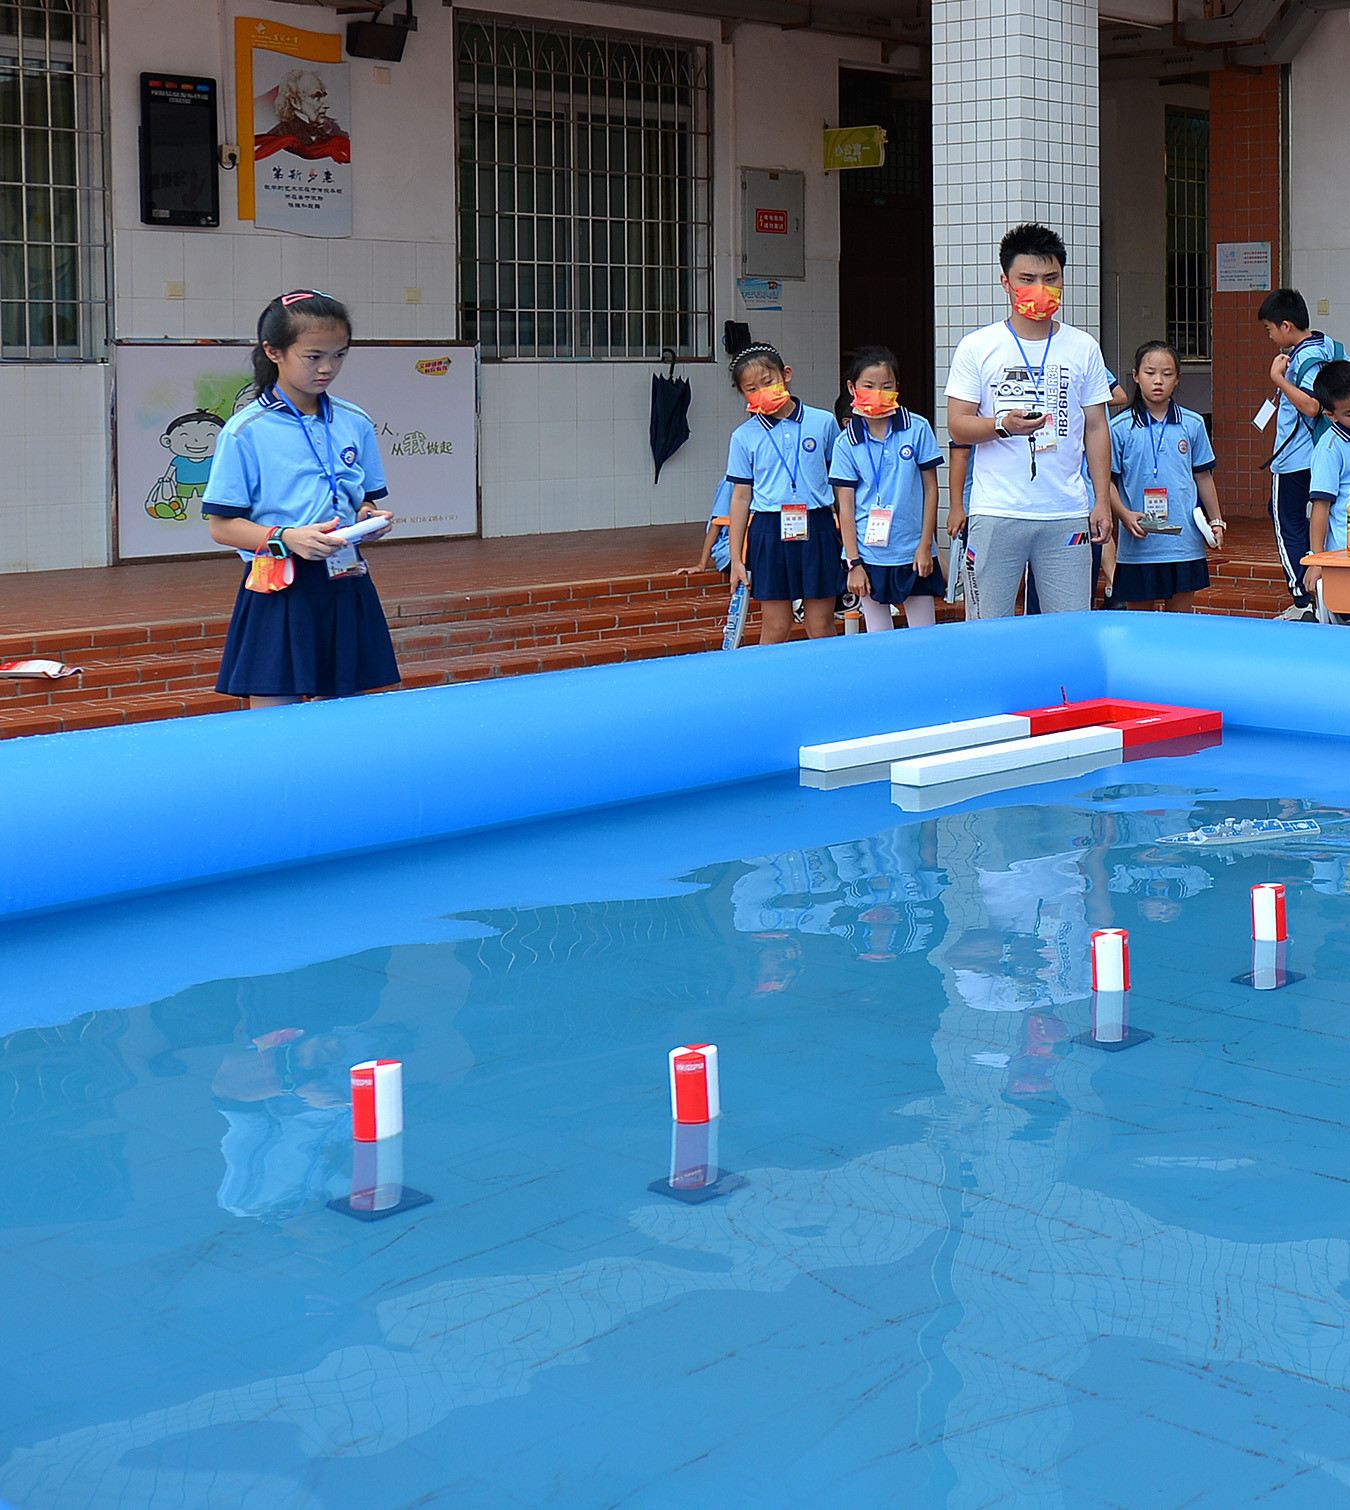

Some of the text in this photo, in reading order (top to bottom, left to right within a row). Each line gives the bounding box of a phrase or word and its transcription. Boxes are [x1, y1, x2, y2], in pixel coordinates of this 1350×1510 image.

[1047, 364, 1059, 388] R34
[1058, 364, 1069, 437] RB26DETT
[391, 430, 453, 456] 从我做起
